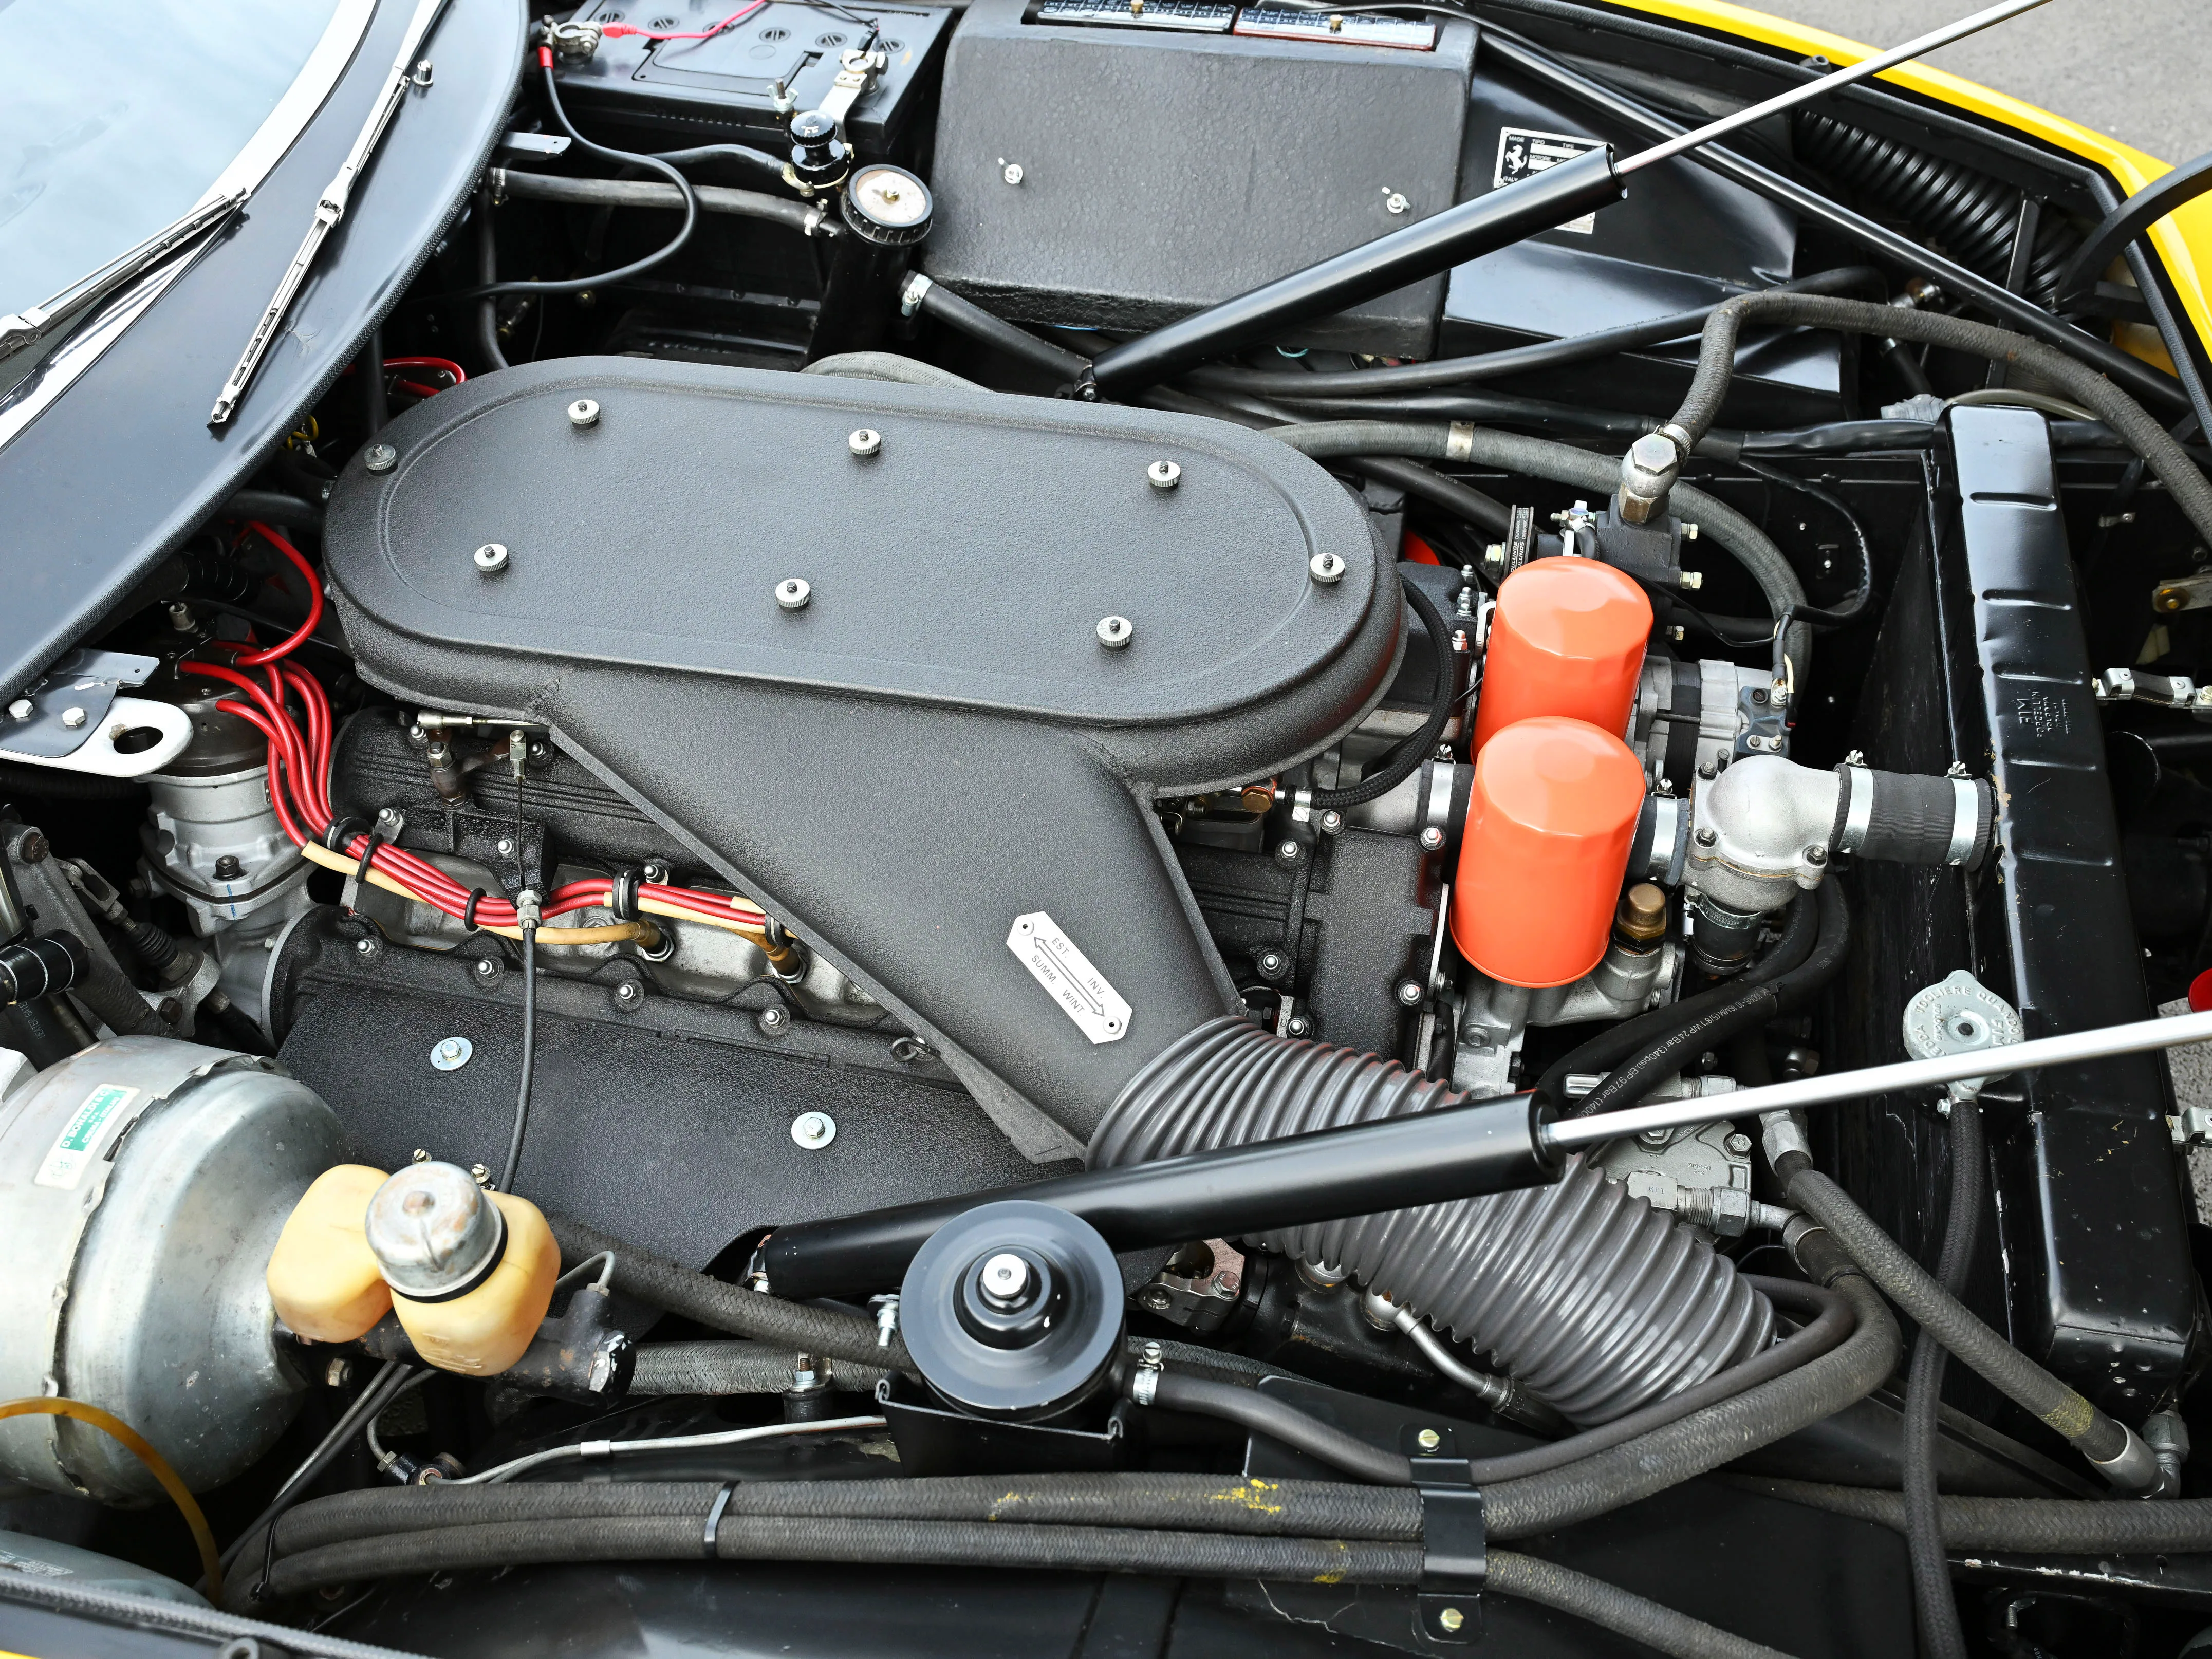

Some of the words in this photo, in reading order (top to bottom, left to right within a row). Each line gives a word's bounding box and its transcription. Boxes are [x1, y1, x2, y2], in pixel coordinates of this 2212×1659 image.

[1509, 135, 1525, 143] MADE
[1529, 154, 1552, 162] MOTORE
[1051, 937, 1069, 958] EST.
[1087, 978, 1105, 998] INV.
[1031, 955, 1057, 984] SUMM.
[1062, 989, 1085, 1016] WINT.
[1991, 1019, 2005, 1046] FIM
